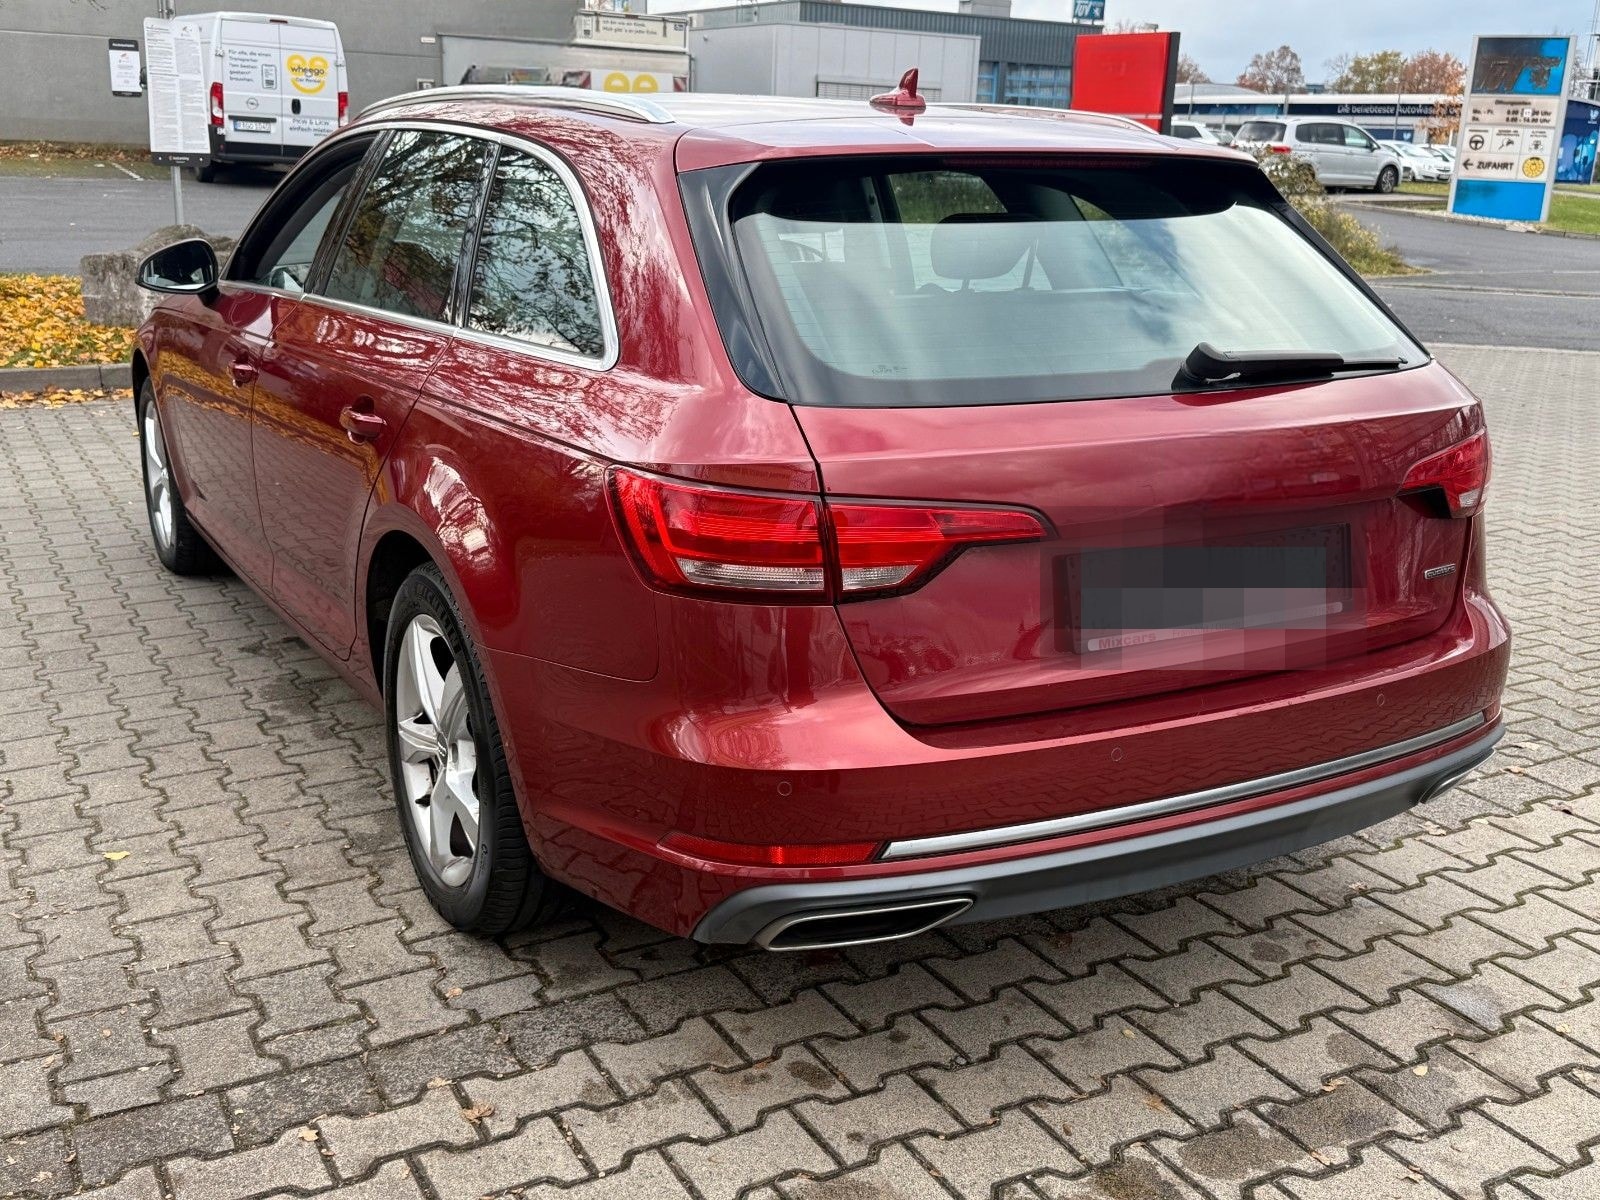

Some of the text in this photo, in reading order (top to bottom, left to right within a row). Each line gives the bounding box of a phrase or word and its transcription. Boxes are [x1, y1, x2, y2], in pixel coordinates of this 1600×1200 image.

[290, 65, 325, 75] wheego
[1337, 104, 1350, 114] Die
[1351, 105, 1395, 114] beliebteste
[1477, 161, 1514, 170] ZUFAHRT
[1099, 631, 1156, 649] Mixcars
